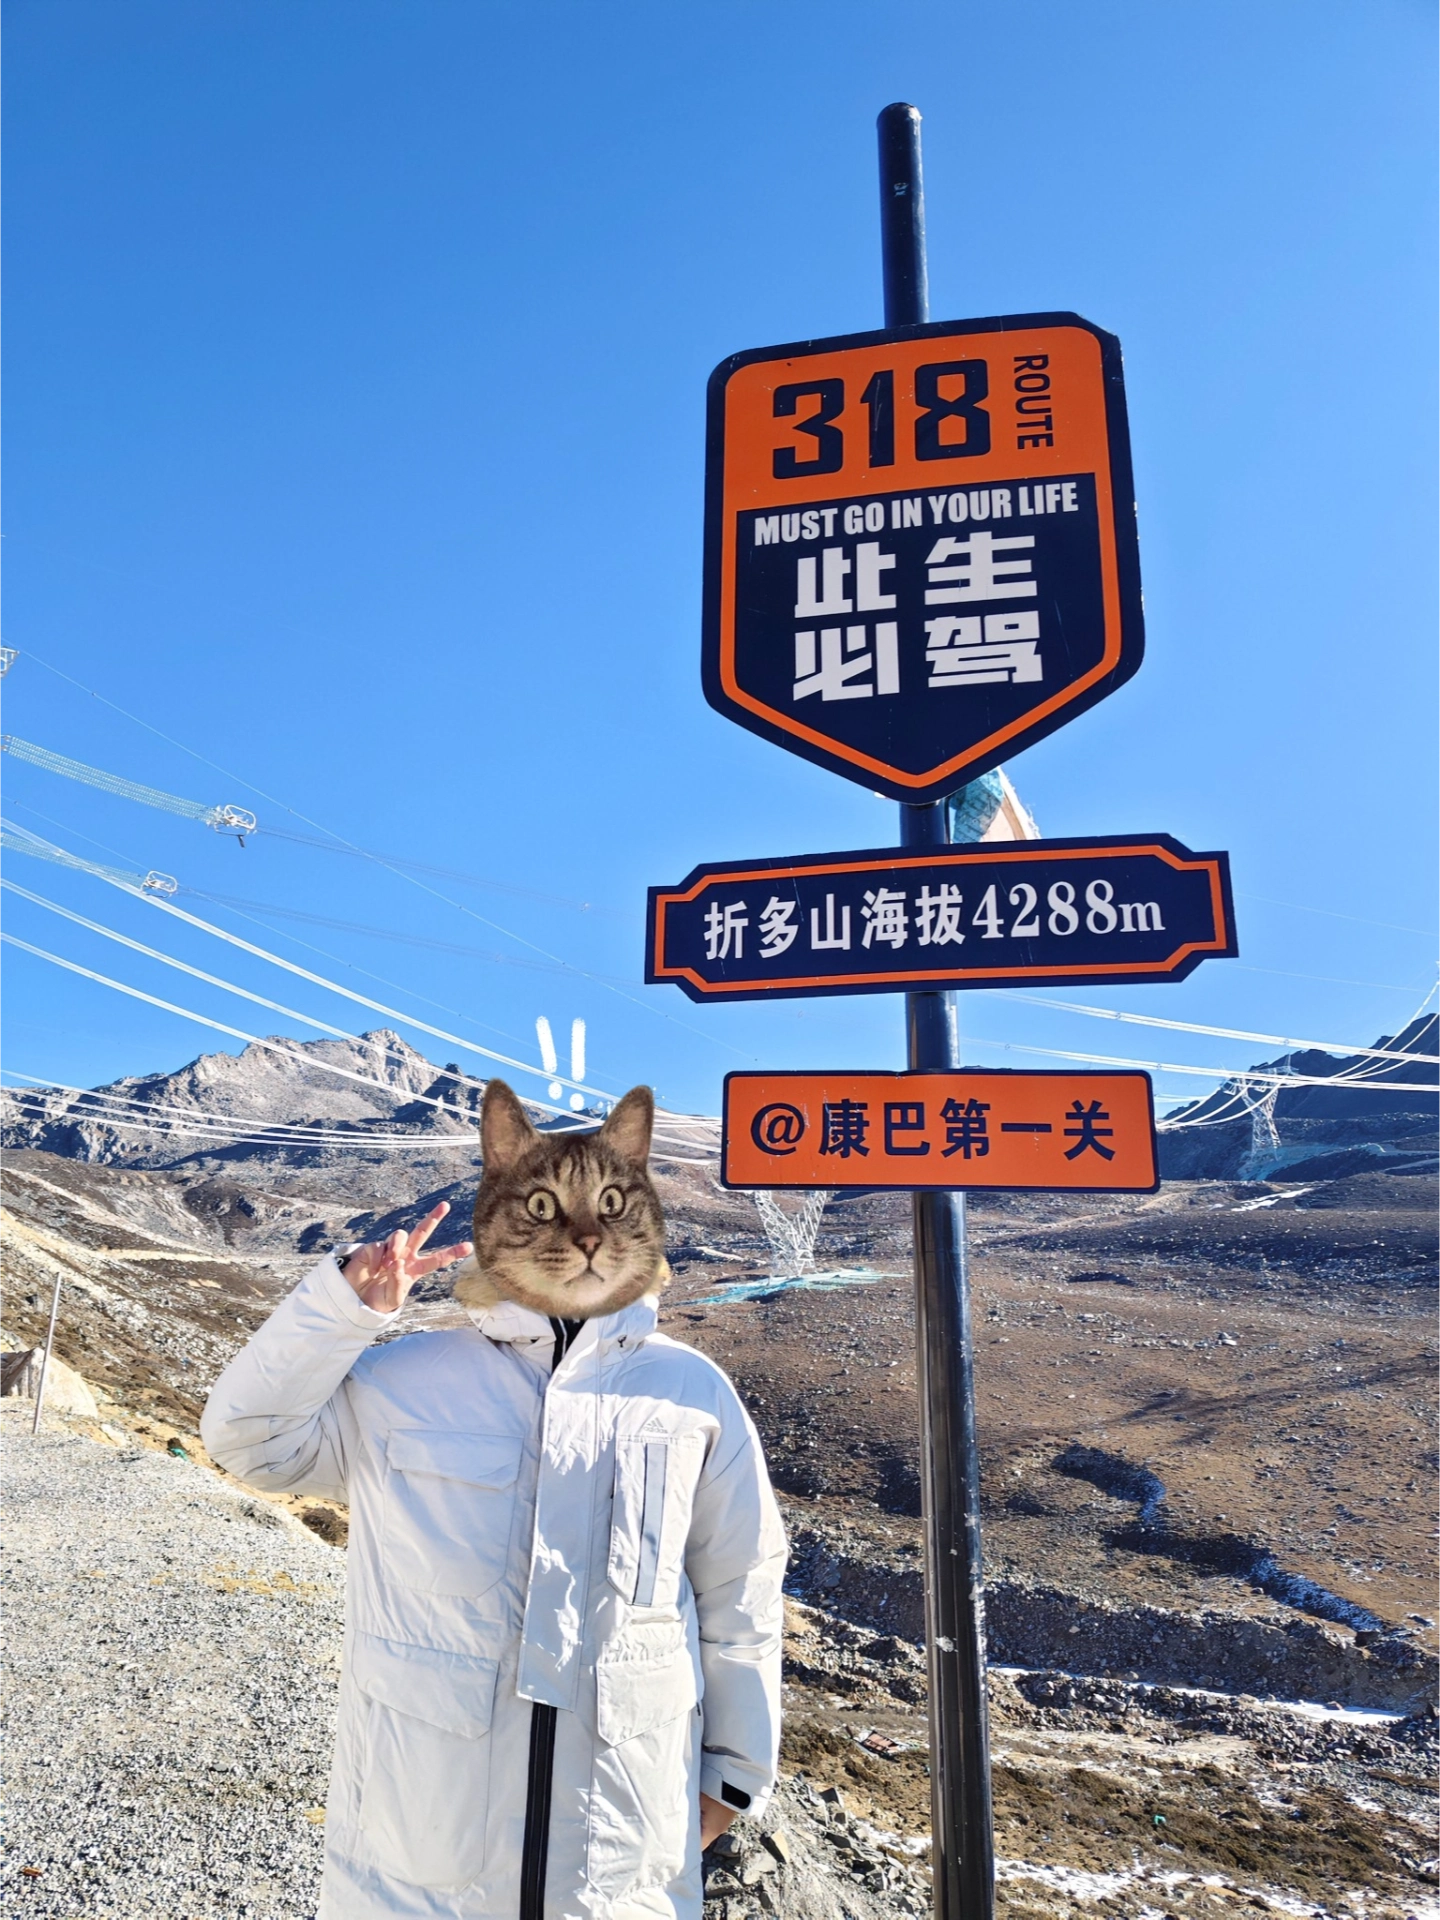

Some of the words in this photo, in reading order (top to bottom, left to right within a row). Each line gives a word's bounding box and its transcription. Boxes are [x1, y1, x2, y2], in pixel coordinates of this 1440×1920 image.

[773, 358, 991, 480] 318
[1012, 353, 1054, 450] ROUTE
[754, 508, 838, 546] MUST
[843, 500, 885, 536] GO
[891, 497, 923, 530] IN
[927, 487, 1012, 524] YOUR
[1018, 482, 1079, 516] LIFE
[794, 530, 1038, 619] 此生
[792, 609, 1044, 702] 必驾
[703, 878, 1166, 961] 折多山海拔4288m
[750, 1097, 1116, 1162] @康巴第一关
[644, 1425, 668, 1434] adidas
